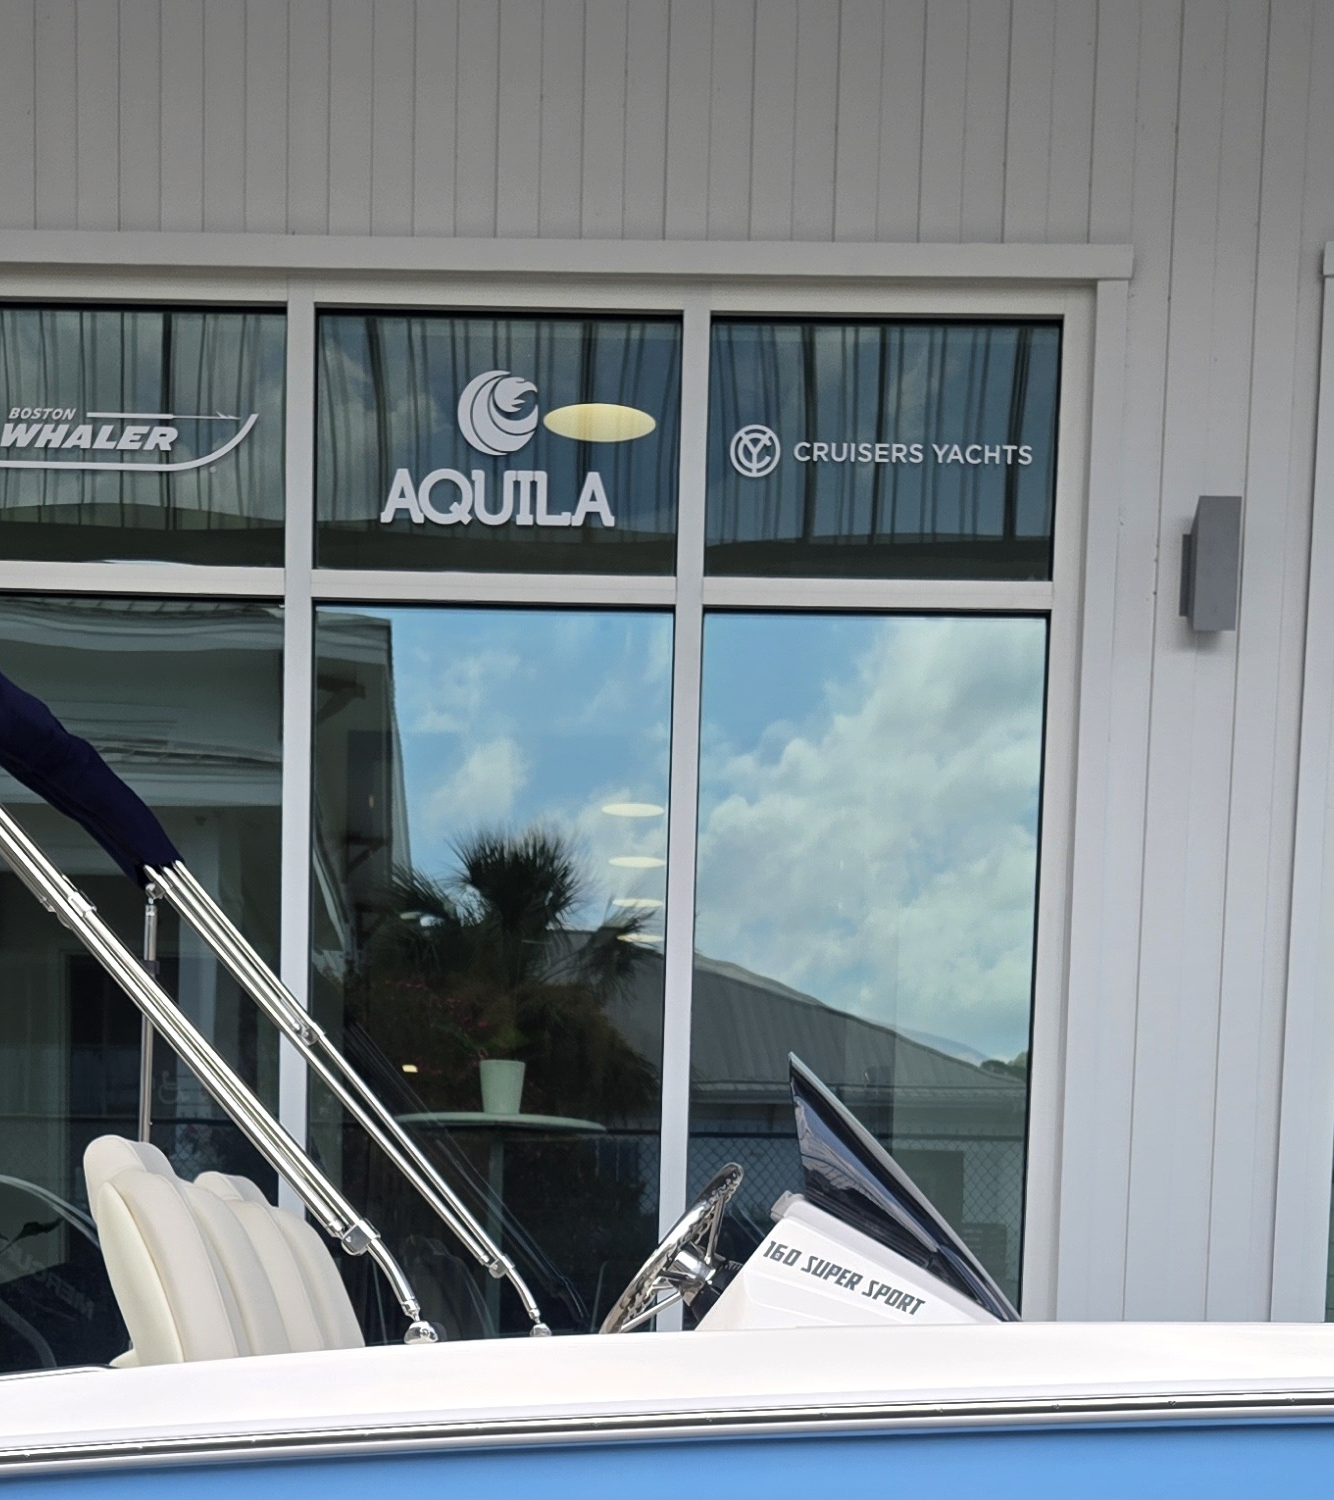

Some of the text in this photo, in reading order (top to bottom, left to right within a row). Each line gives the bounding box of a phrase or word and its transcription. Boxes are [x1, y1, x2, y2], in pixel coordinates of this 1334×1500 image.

[8, 407, 77, 421] BOSTON
[0, 423, 179, 451] WHALER
[793, 441, 1034, 466] CRUISERS YACHTS
[380, 468, 615, 527] AQUILA
[763, 1240, 926, 1315] 160 SUPER SPORT
